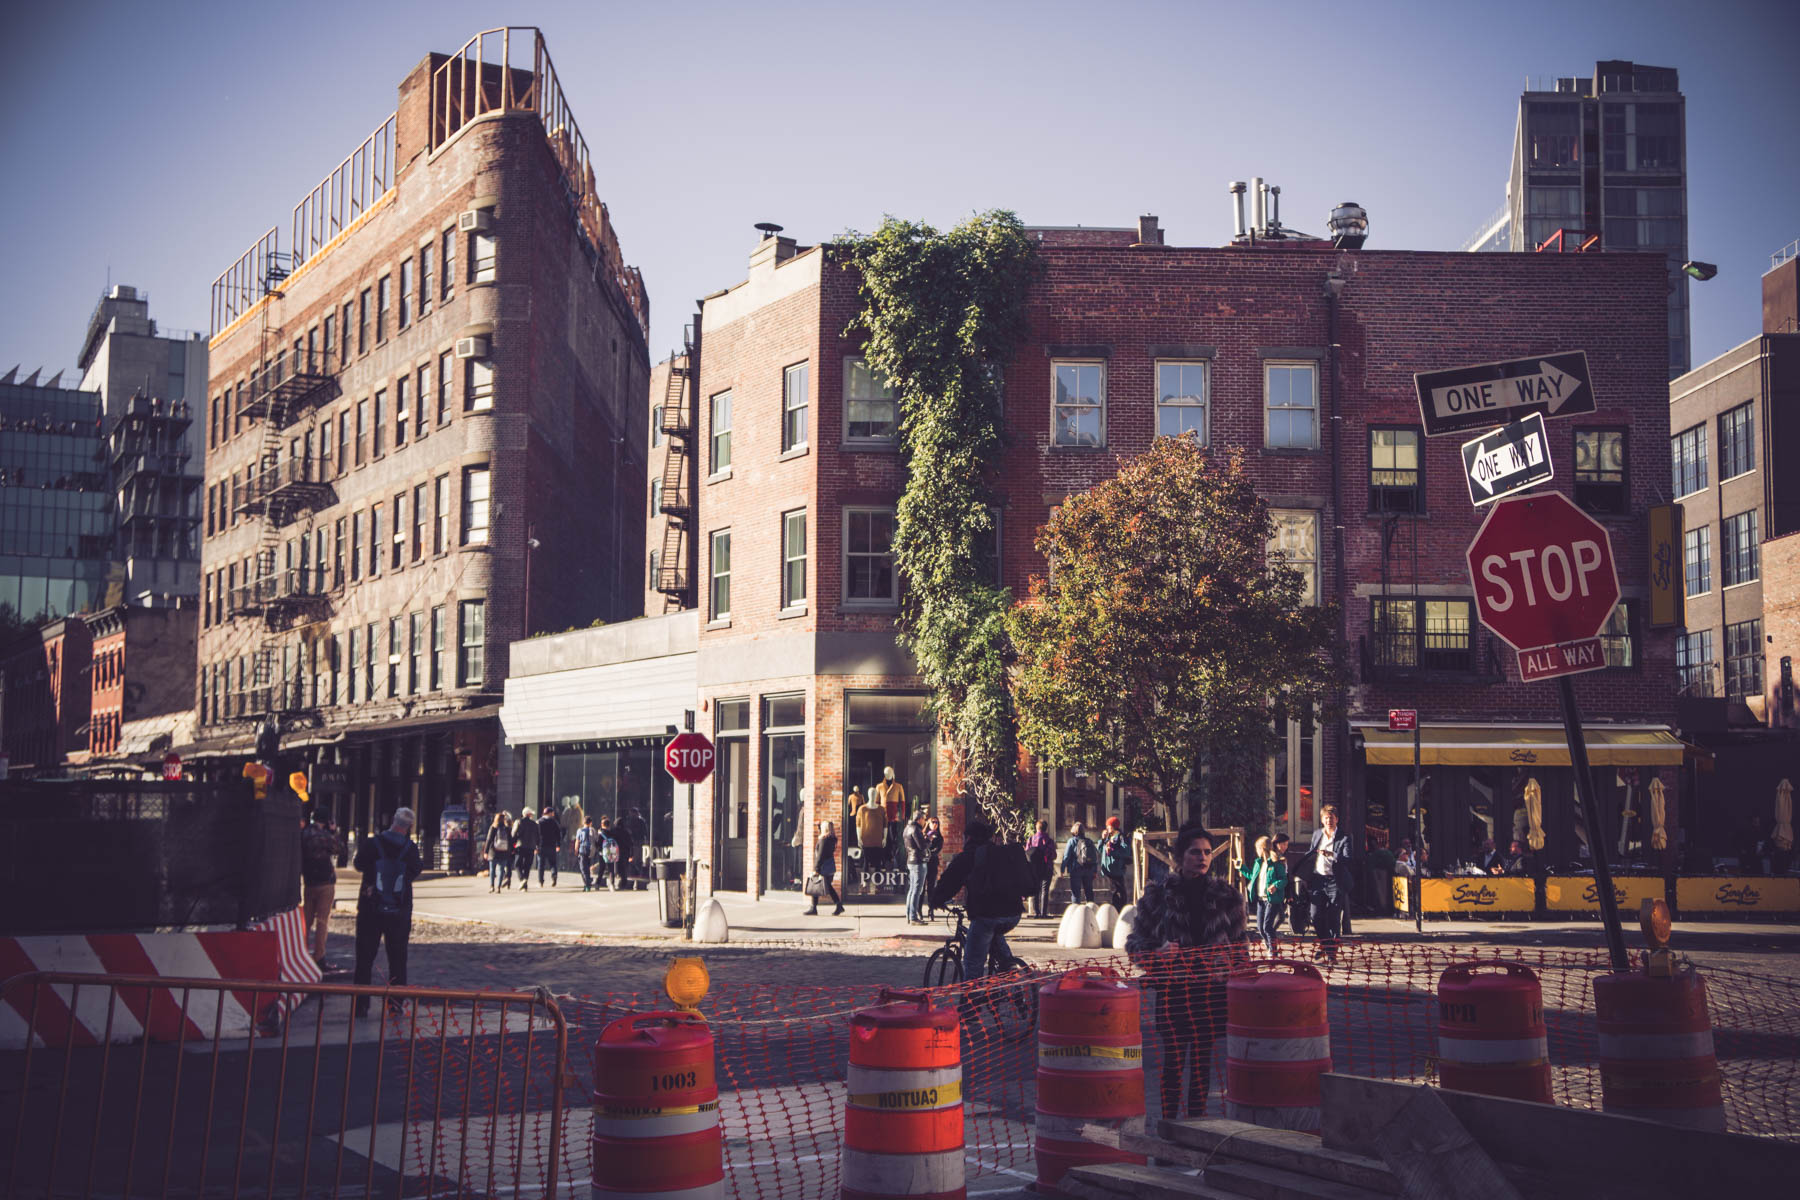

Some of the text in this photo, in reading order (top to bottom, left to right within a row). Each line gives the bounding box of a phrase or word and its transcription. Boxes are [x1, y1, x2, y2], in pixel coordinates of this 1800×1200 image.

[1447, 374, 1564, 412] ONE WAY
[1478, 453, 1501, 482] ONE
[1509, 438, 1535, 469] WAY
[1481, 539, 1601, 612] STOP
[1527, 644, 1595, 674] ALL WAY
[163, 763, 182, 777] STOP
[668, 748, 713, 768] STOP
[652, 1071, 697, 1091] 1003
